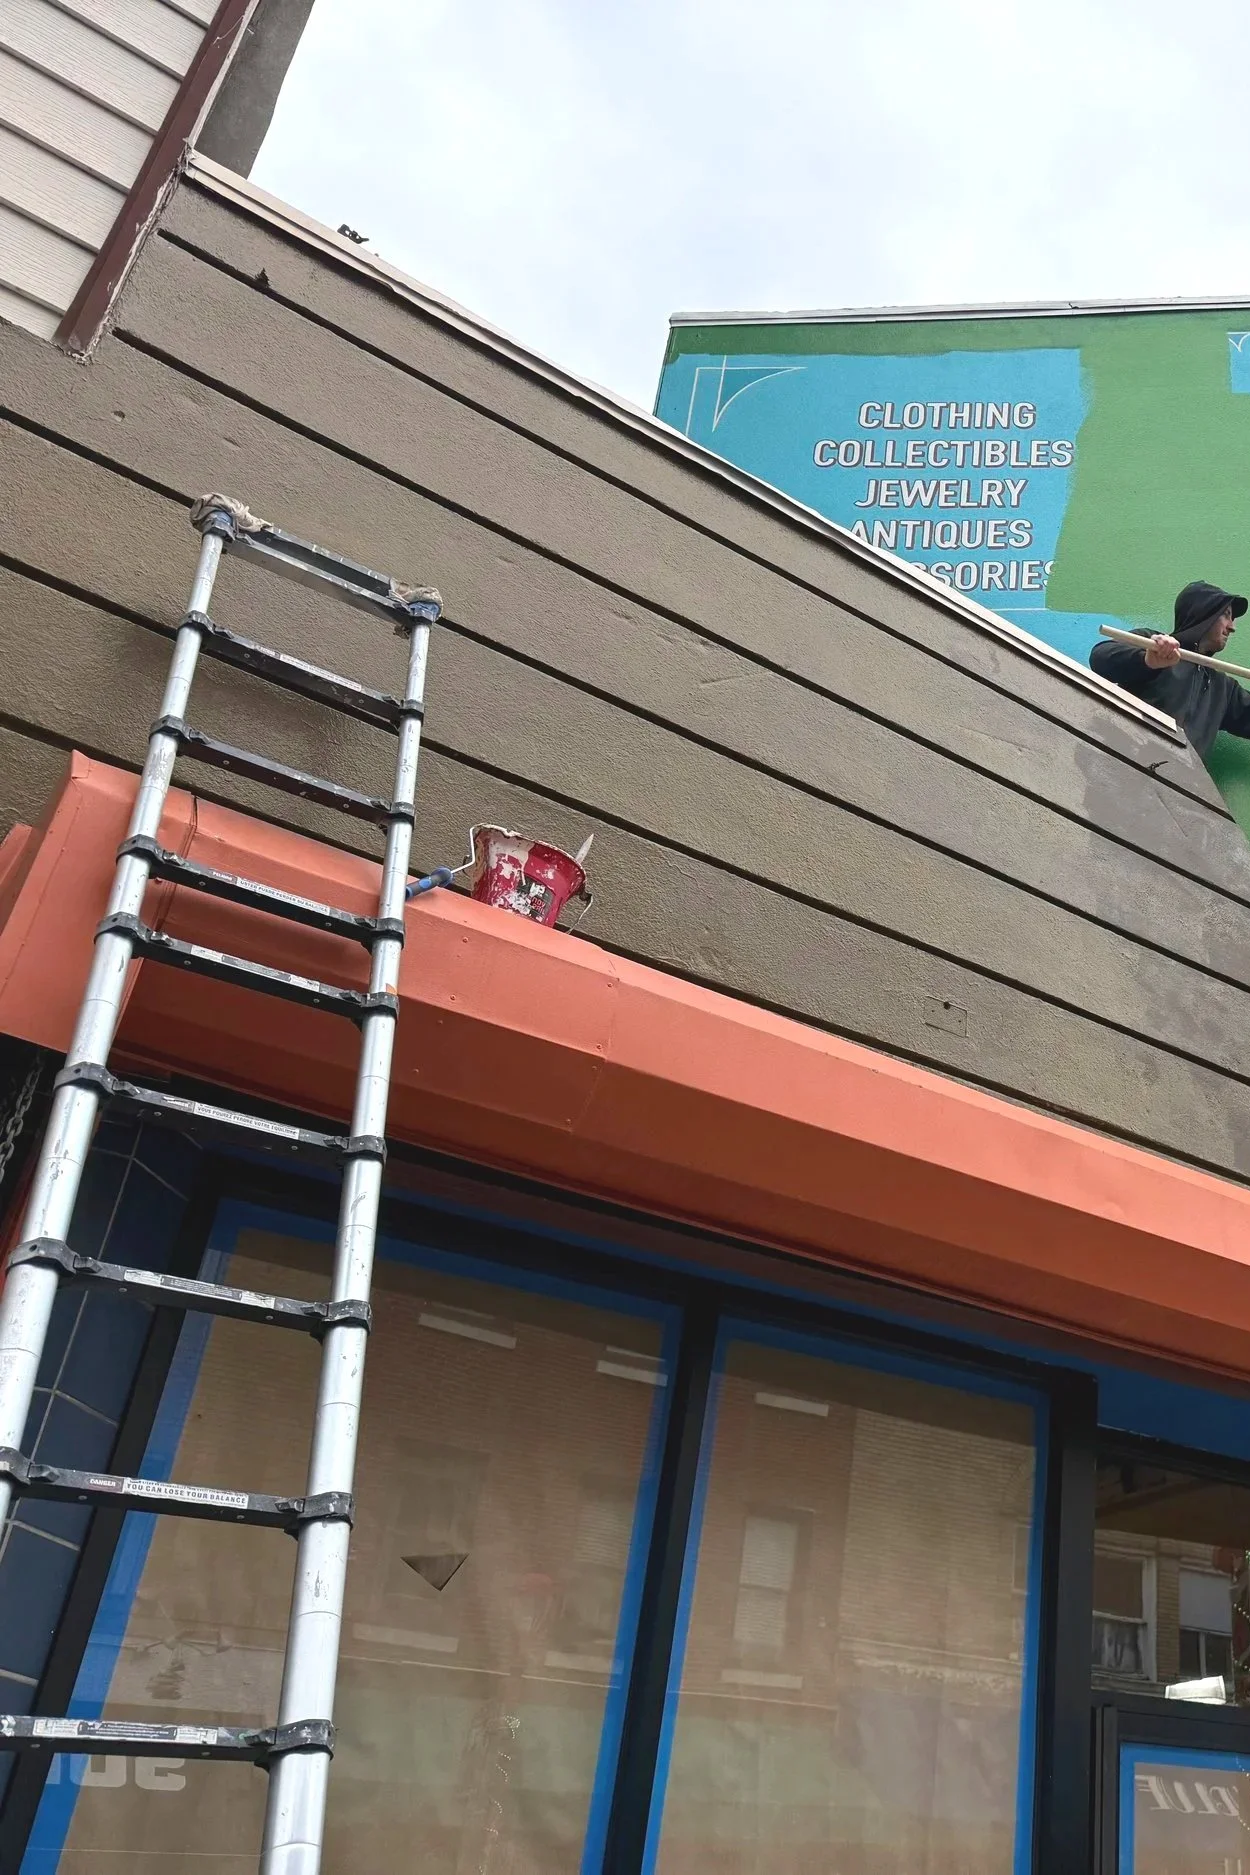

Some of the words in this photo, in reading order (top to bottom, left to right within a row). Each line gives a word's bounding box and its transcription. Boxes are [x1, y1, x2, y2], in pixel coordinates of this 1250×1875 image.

[858, 401, 1037, 430] CLOTHING
[813, 440, 1074, 468] COLLECTIBLES
[854, 479, 1029, 508] JEWELRY
[850, 519, 1033, 549] ANTIQUES
[89, 1478, 116, 1487] DANGER
[127, 1483, 143, 1491] YOU
[145, 1485, 161, 1494] CAN
[164, 1487, 184, 1496] LOSE
[187, 1491, 208, 1500] YOUR
[209, 1494, 246, 1504] BALANCE
